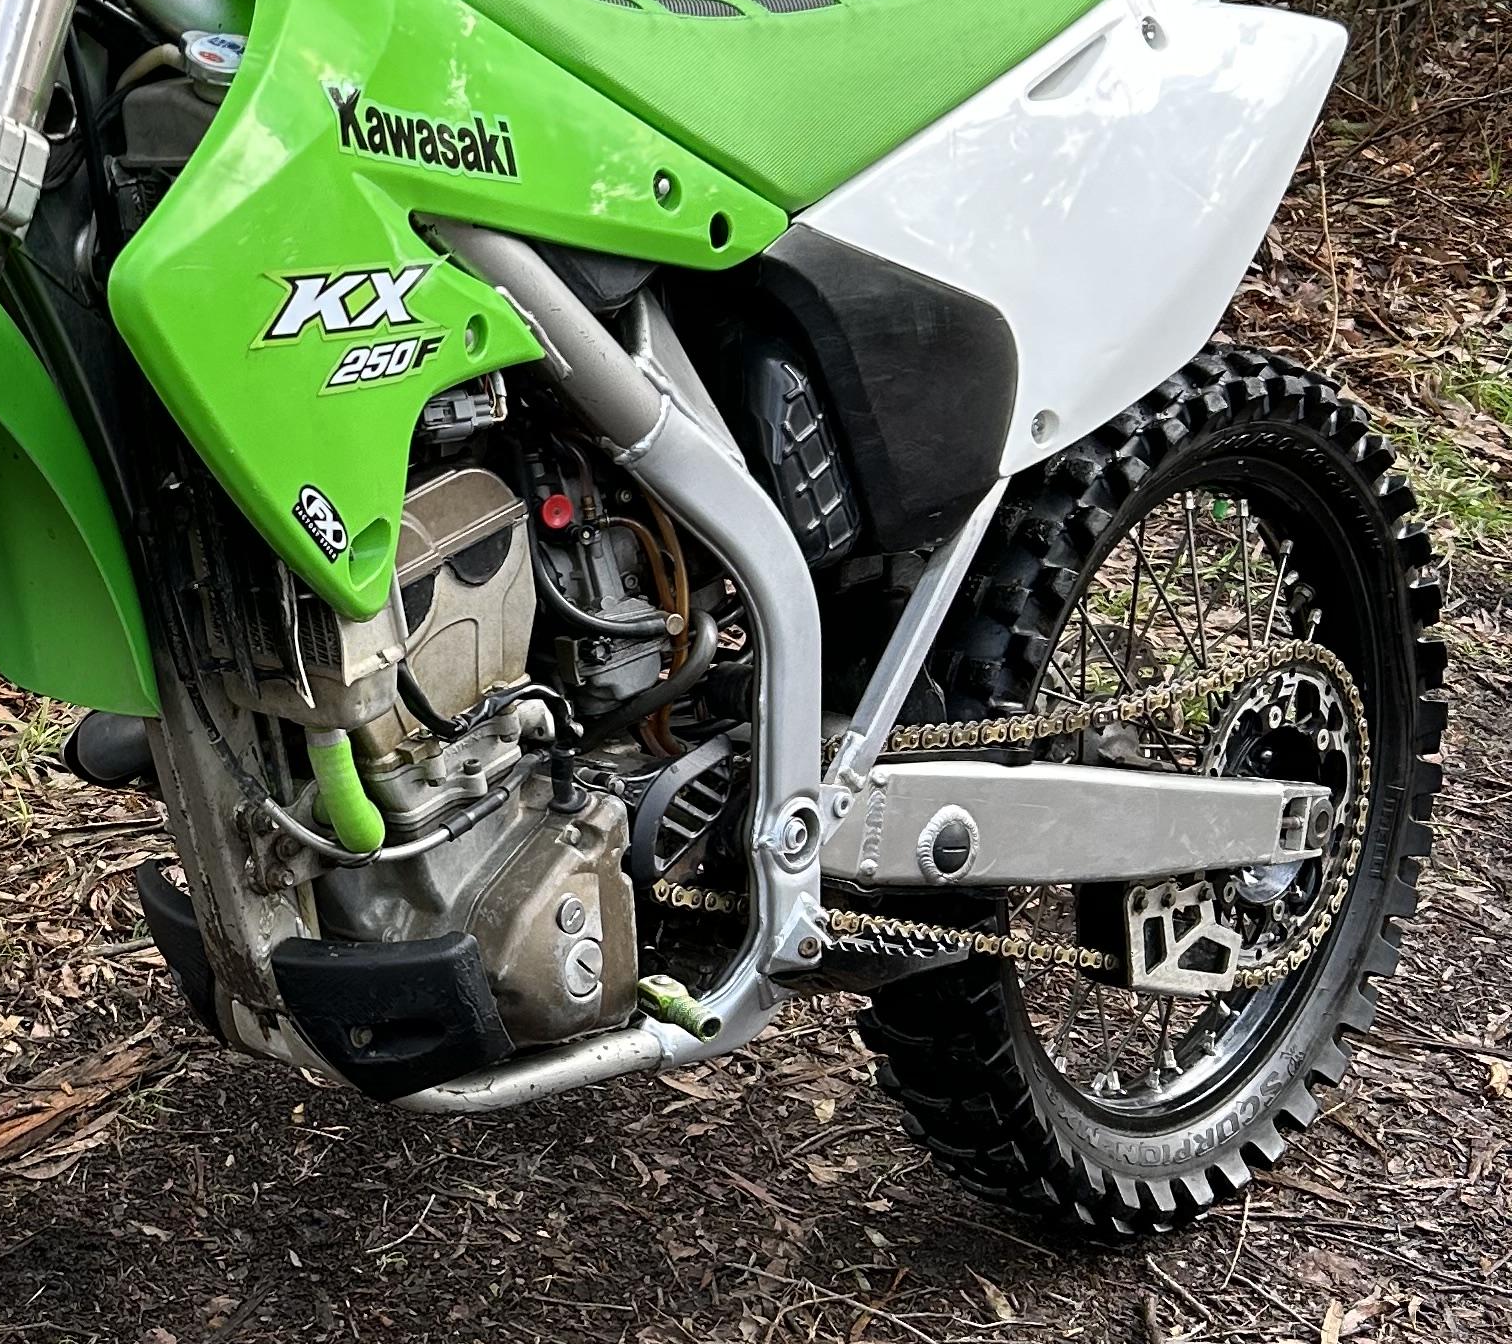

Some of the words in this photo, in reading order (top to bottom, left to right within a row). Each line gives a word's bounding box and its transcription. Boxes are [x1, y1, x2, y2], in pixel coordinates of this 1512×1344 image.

[326, 85, 520, 178] Kawasaki
[263, 263, 438, 341] KX
[326, 334, 445, 390] 250F
